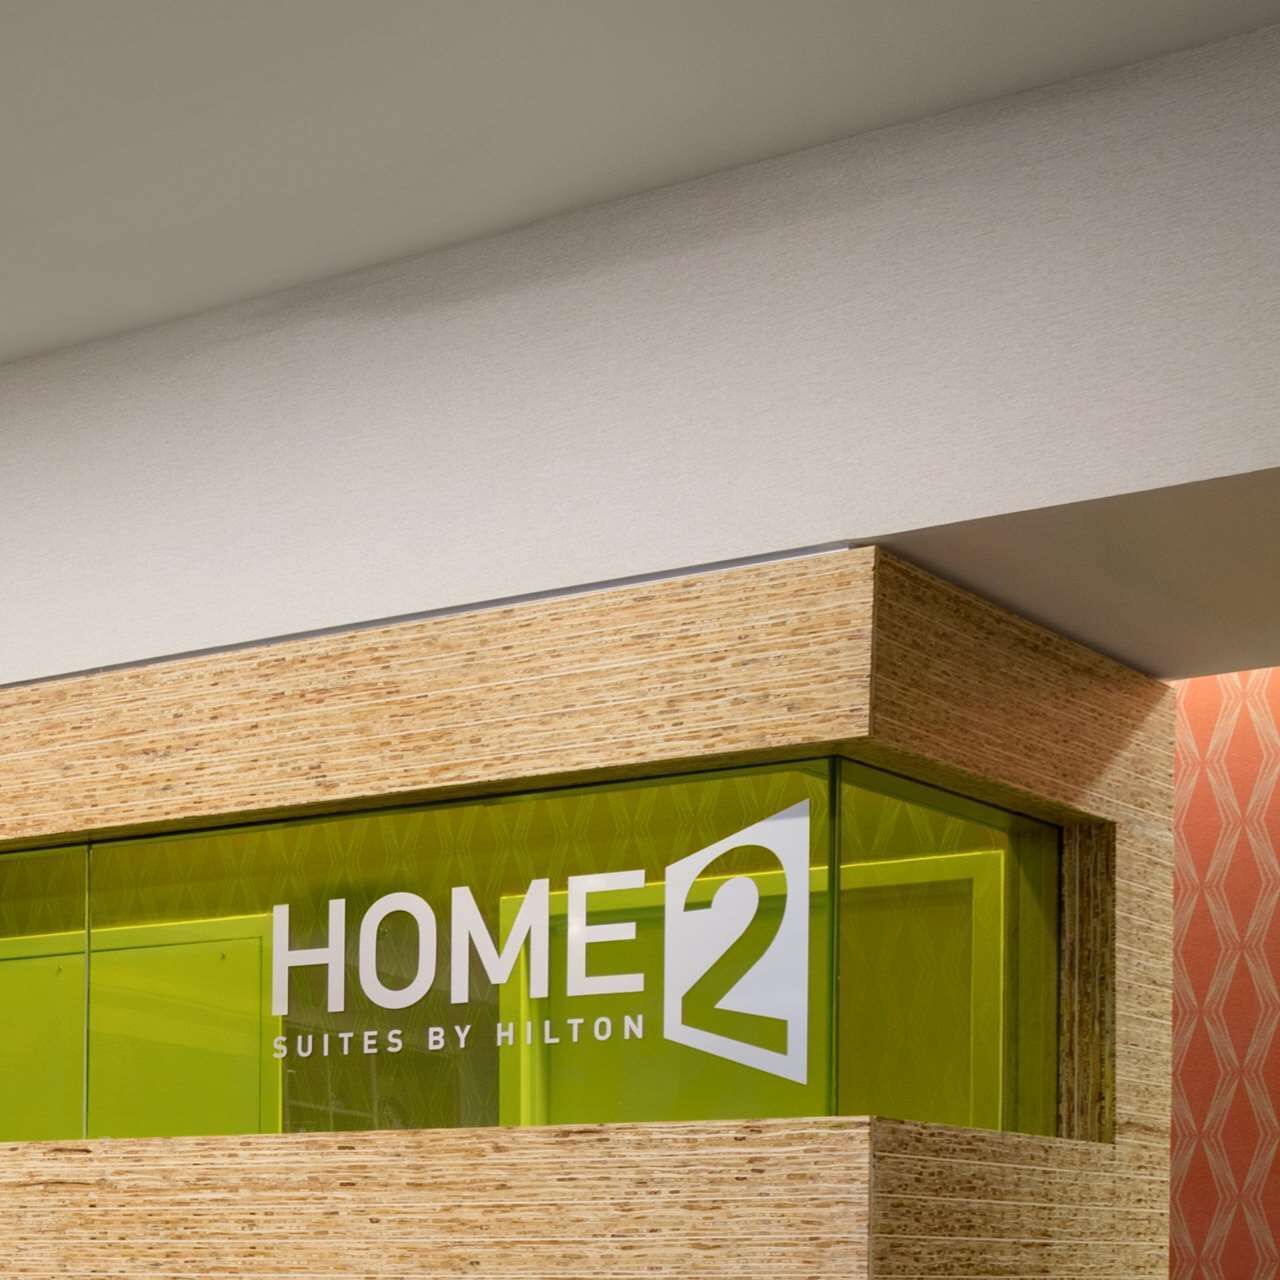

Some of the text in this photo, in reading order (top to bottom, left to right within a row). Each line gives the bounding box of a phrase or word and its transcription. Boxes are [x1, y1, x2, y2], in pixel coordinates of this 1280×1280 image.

[271, 825, 798, 1068] HOME 2
[272, 1014, 644, 1059] SUITES BY HILTON
